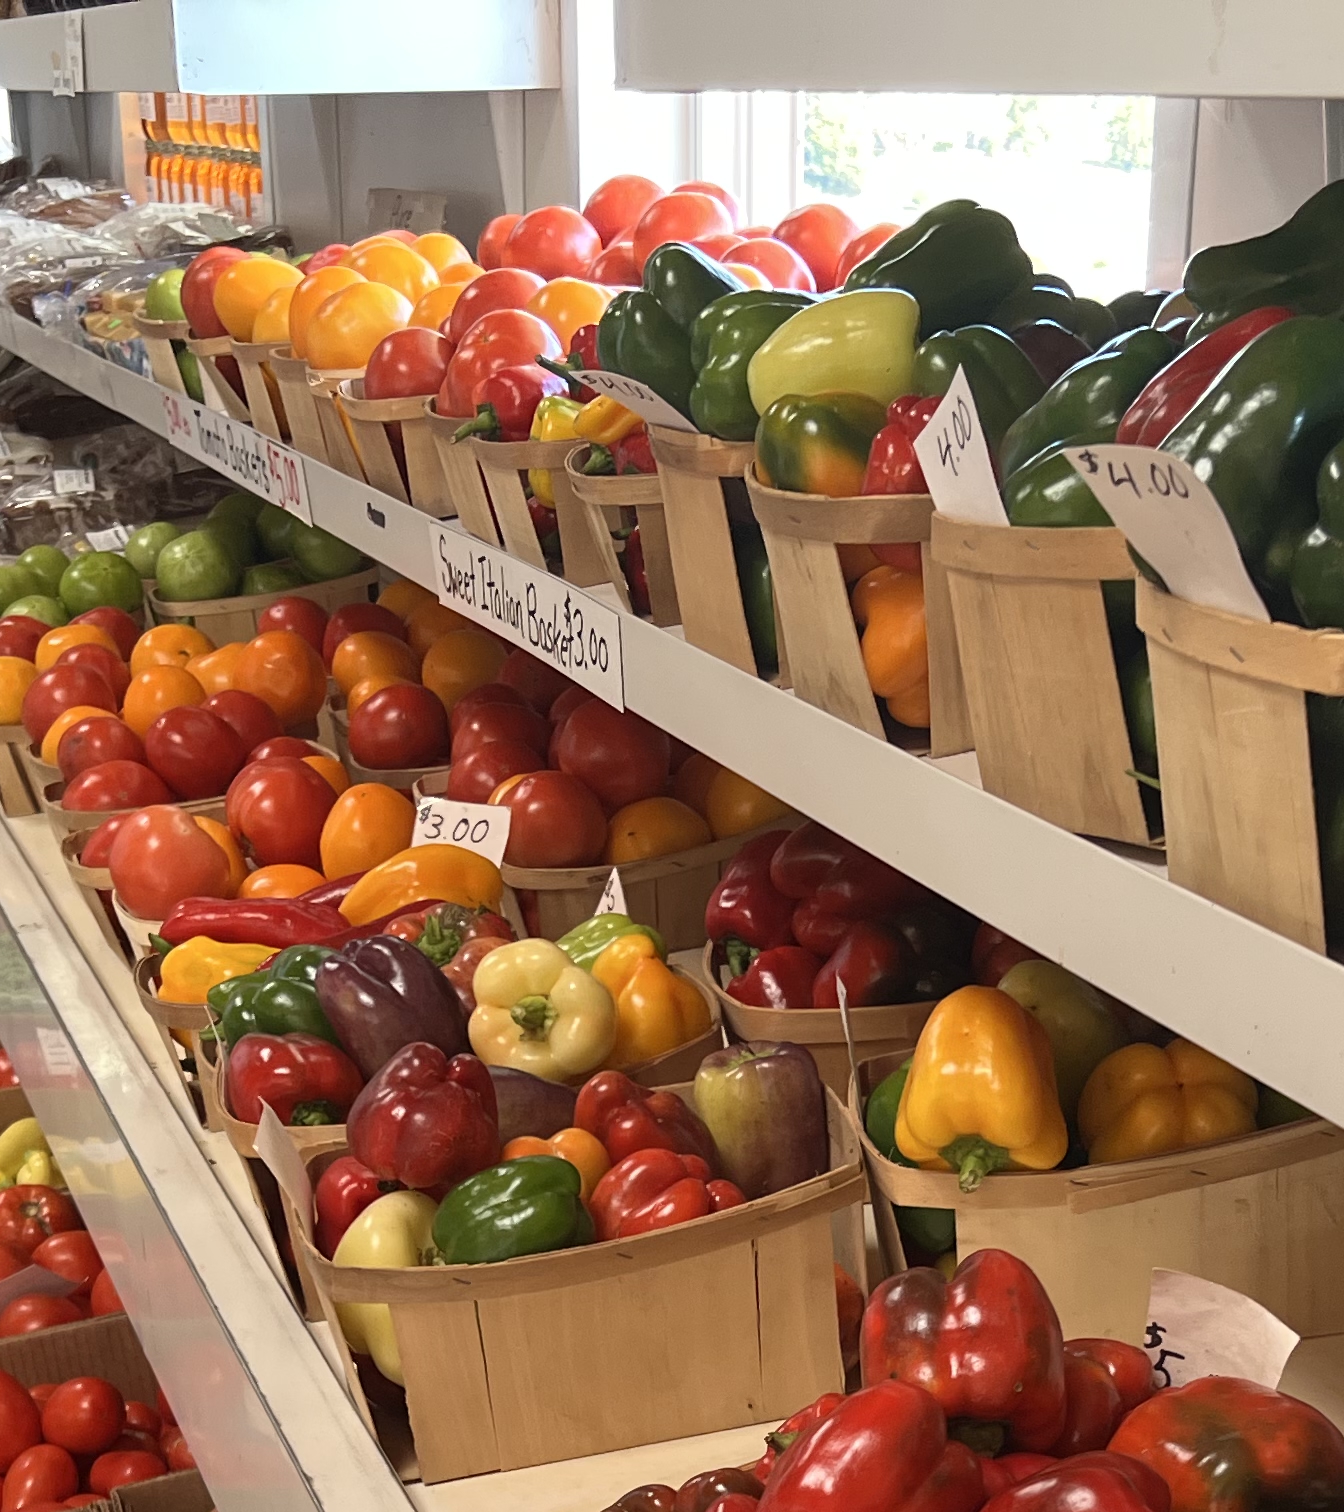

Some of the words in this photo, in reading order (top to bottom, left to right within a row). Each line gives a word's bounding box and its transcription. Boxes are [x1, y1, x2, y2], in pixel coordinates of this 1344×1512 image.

[226, 424, 270, 493] Baskets
[936, 396, 972, 477] 4.00
[1078, 449, 1189, 499] $4.00
[438, 533, 477, 608] Sweet
[477, 556, 525, 639] Italian
[526, 582, 574, 675] Basket
[563, 589, 609, 673] $3.00
[419, 804, 490, 843] $3.00
